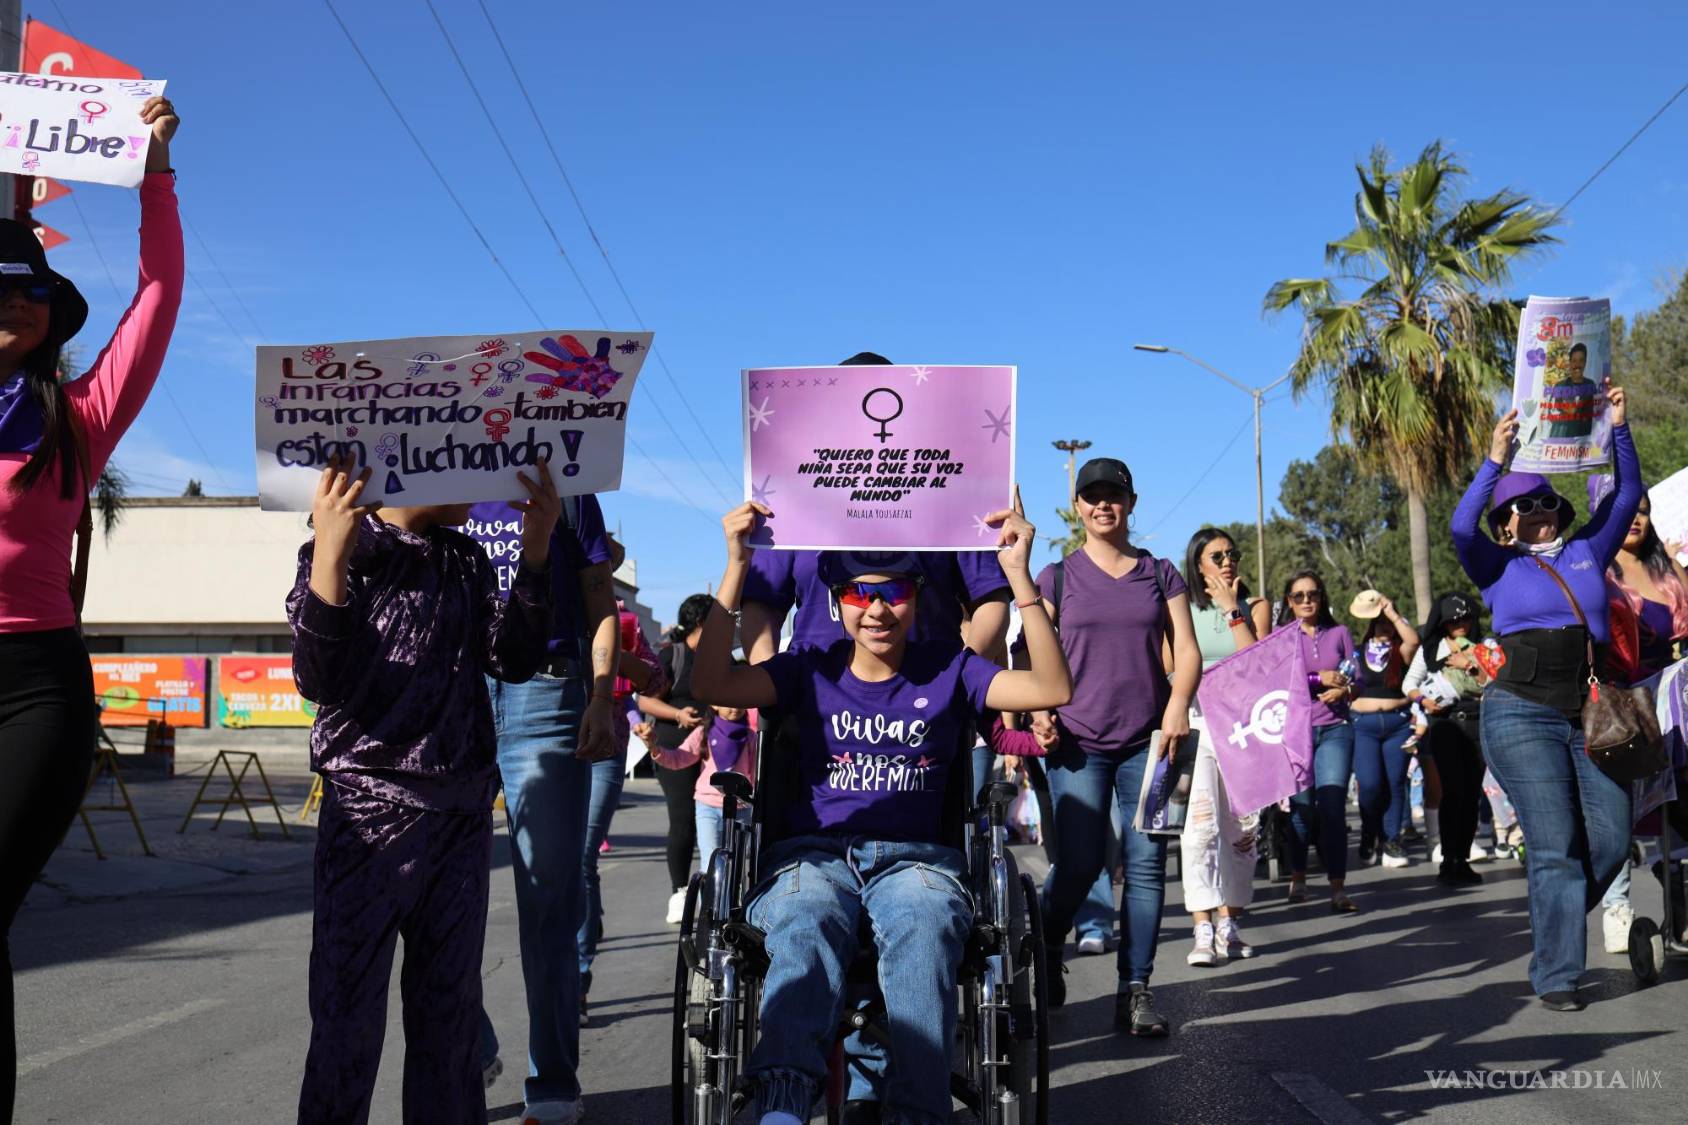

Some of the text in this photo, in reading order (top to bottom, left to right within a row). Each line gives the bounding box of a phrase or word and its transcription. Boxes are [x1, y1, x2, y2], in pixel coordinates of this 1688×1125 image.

[282, 357, 383, 381] Las
[274, 399, 482, 426] marchando
[878, 448, 909, 461] QUE
[914, 449, 950, 460] TODA
[798, 461, 964, 474] NIÑA SEPA QUE SU VOZ
[813, 476, 947, 488] PUEDE CAMBIAR AL
[147, 697, 201, 712] GRATIS
